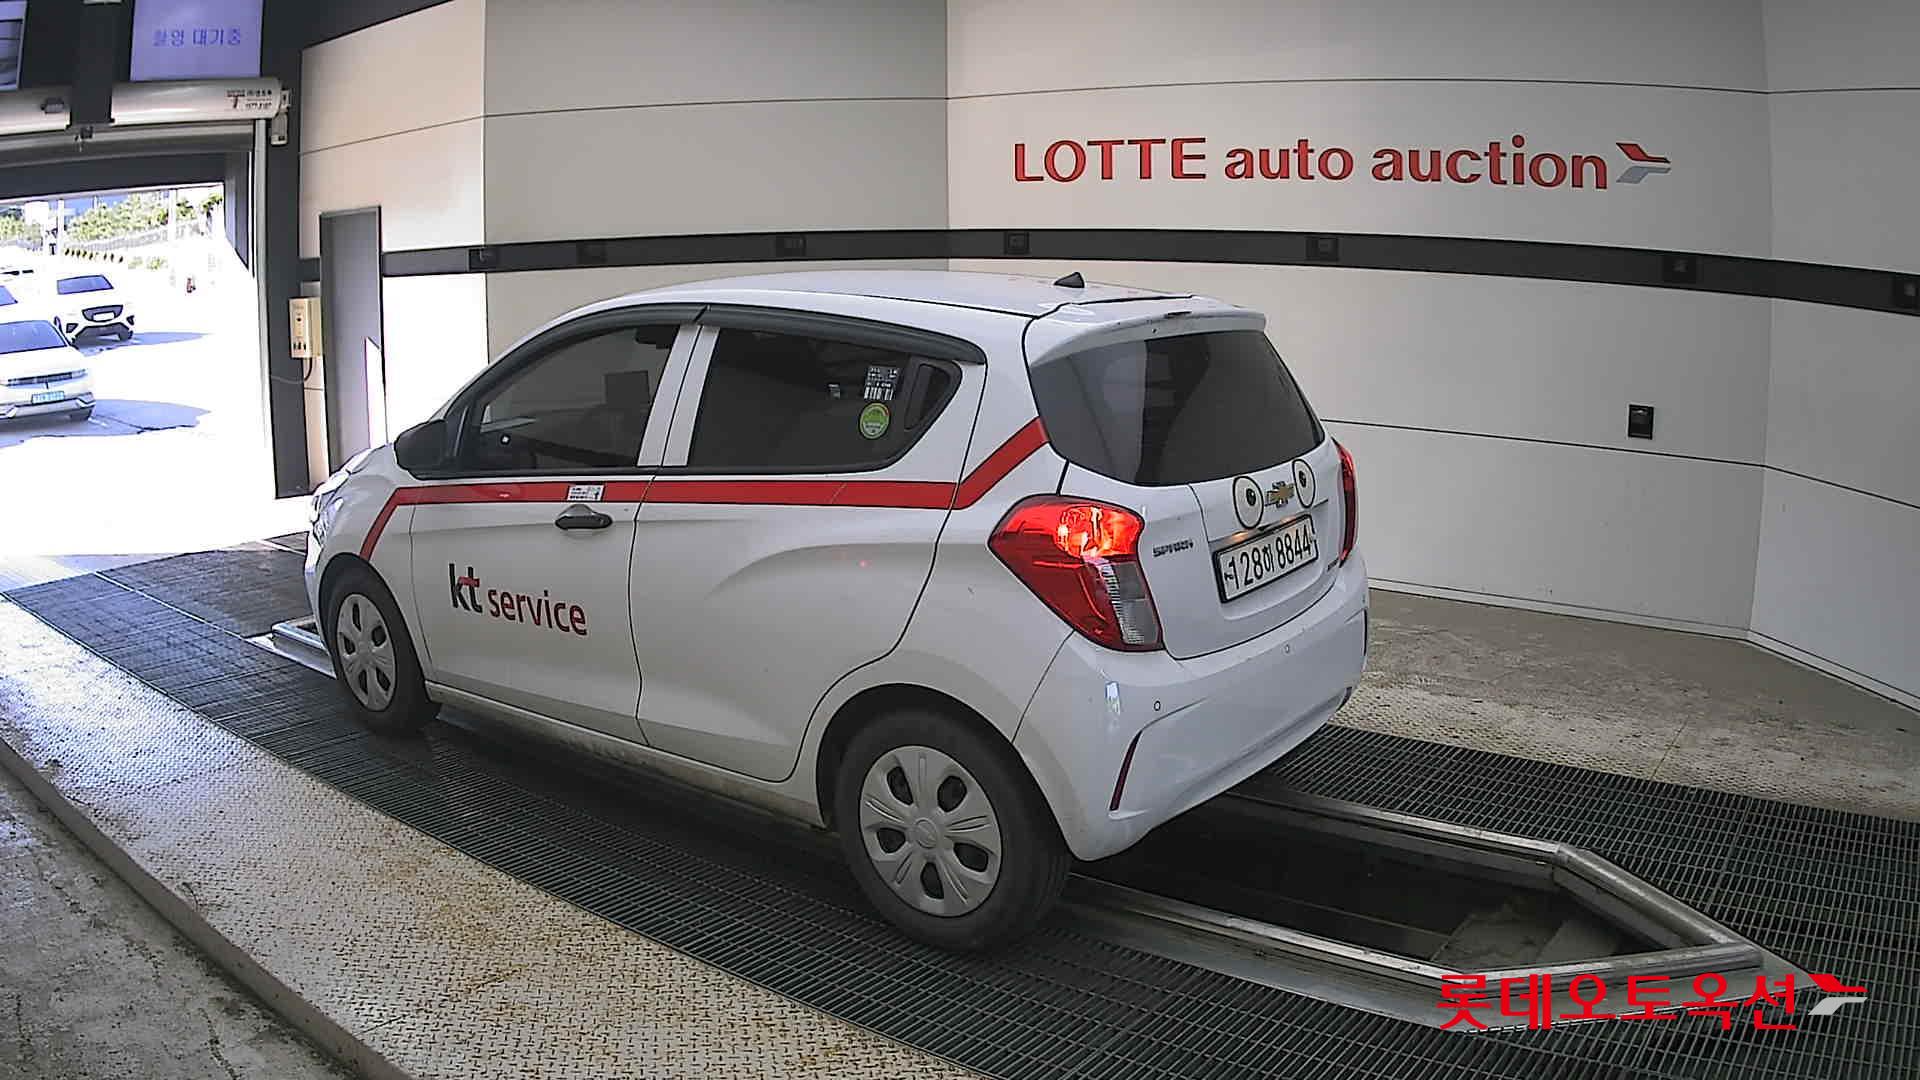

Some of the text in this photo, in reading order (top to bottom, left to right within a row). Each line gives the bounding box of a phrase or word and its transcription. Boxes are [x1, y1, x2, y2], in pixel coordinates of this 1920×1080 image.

[1014, 135, 1608, 190] LOTTE auto auction
[1276, 524, 1312, 569] 8844
[449, 563, 587, 636] kt service
